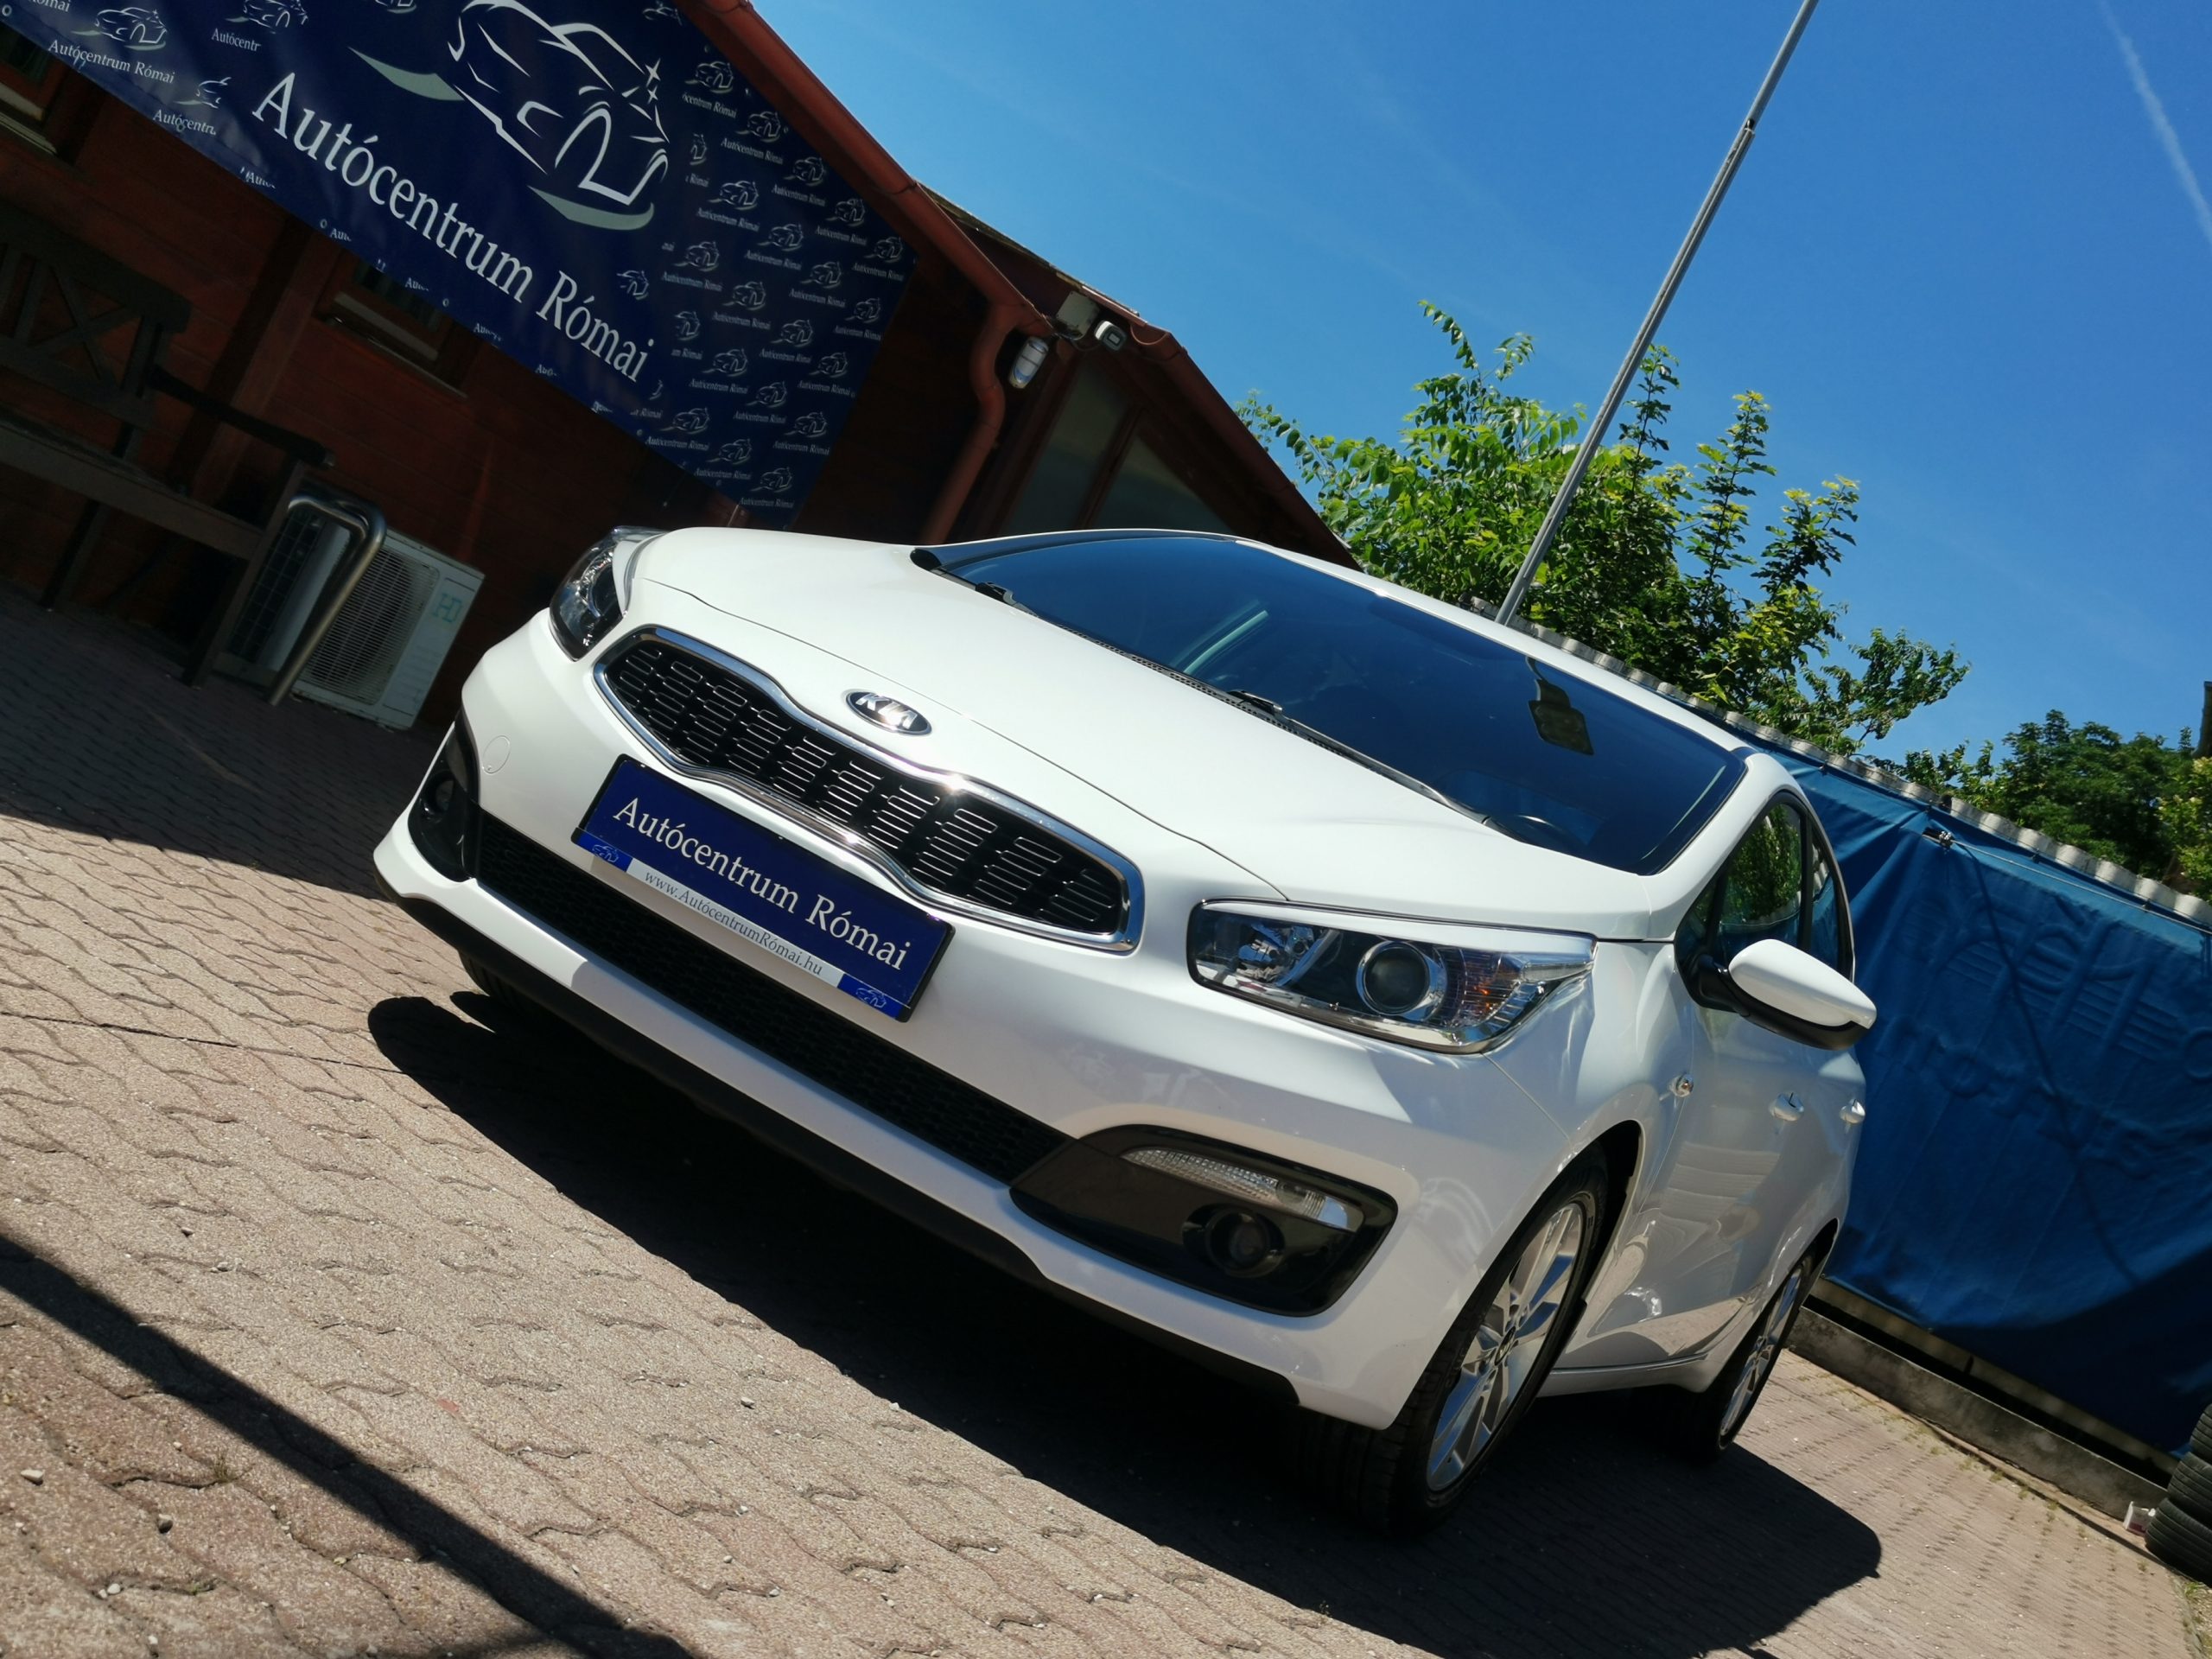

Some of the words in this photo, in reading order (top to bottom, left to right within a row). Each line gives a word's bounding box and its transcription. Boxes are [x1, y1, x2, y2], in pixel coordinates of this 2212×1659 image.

[48, 39, 130, 73] Autócentrum
[134, 61, 175, 84] Római
[251, 72, 534, 303] Autócentrum
[536, 270, 654, 382] Római
[855, 693, 918, 729] KIA
[613, 797, 798, 913] Autócentrum
[806, 893, 912, 970] Római
[645, 871, 823, 976] www.AutócentrumRómai.hu
